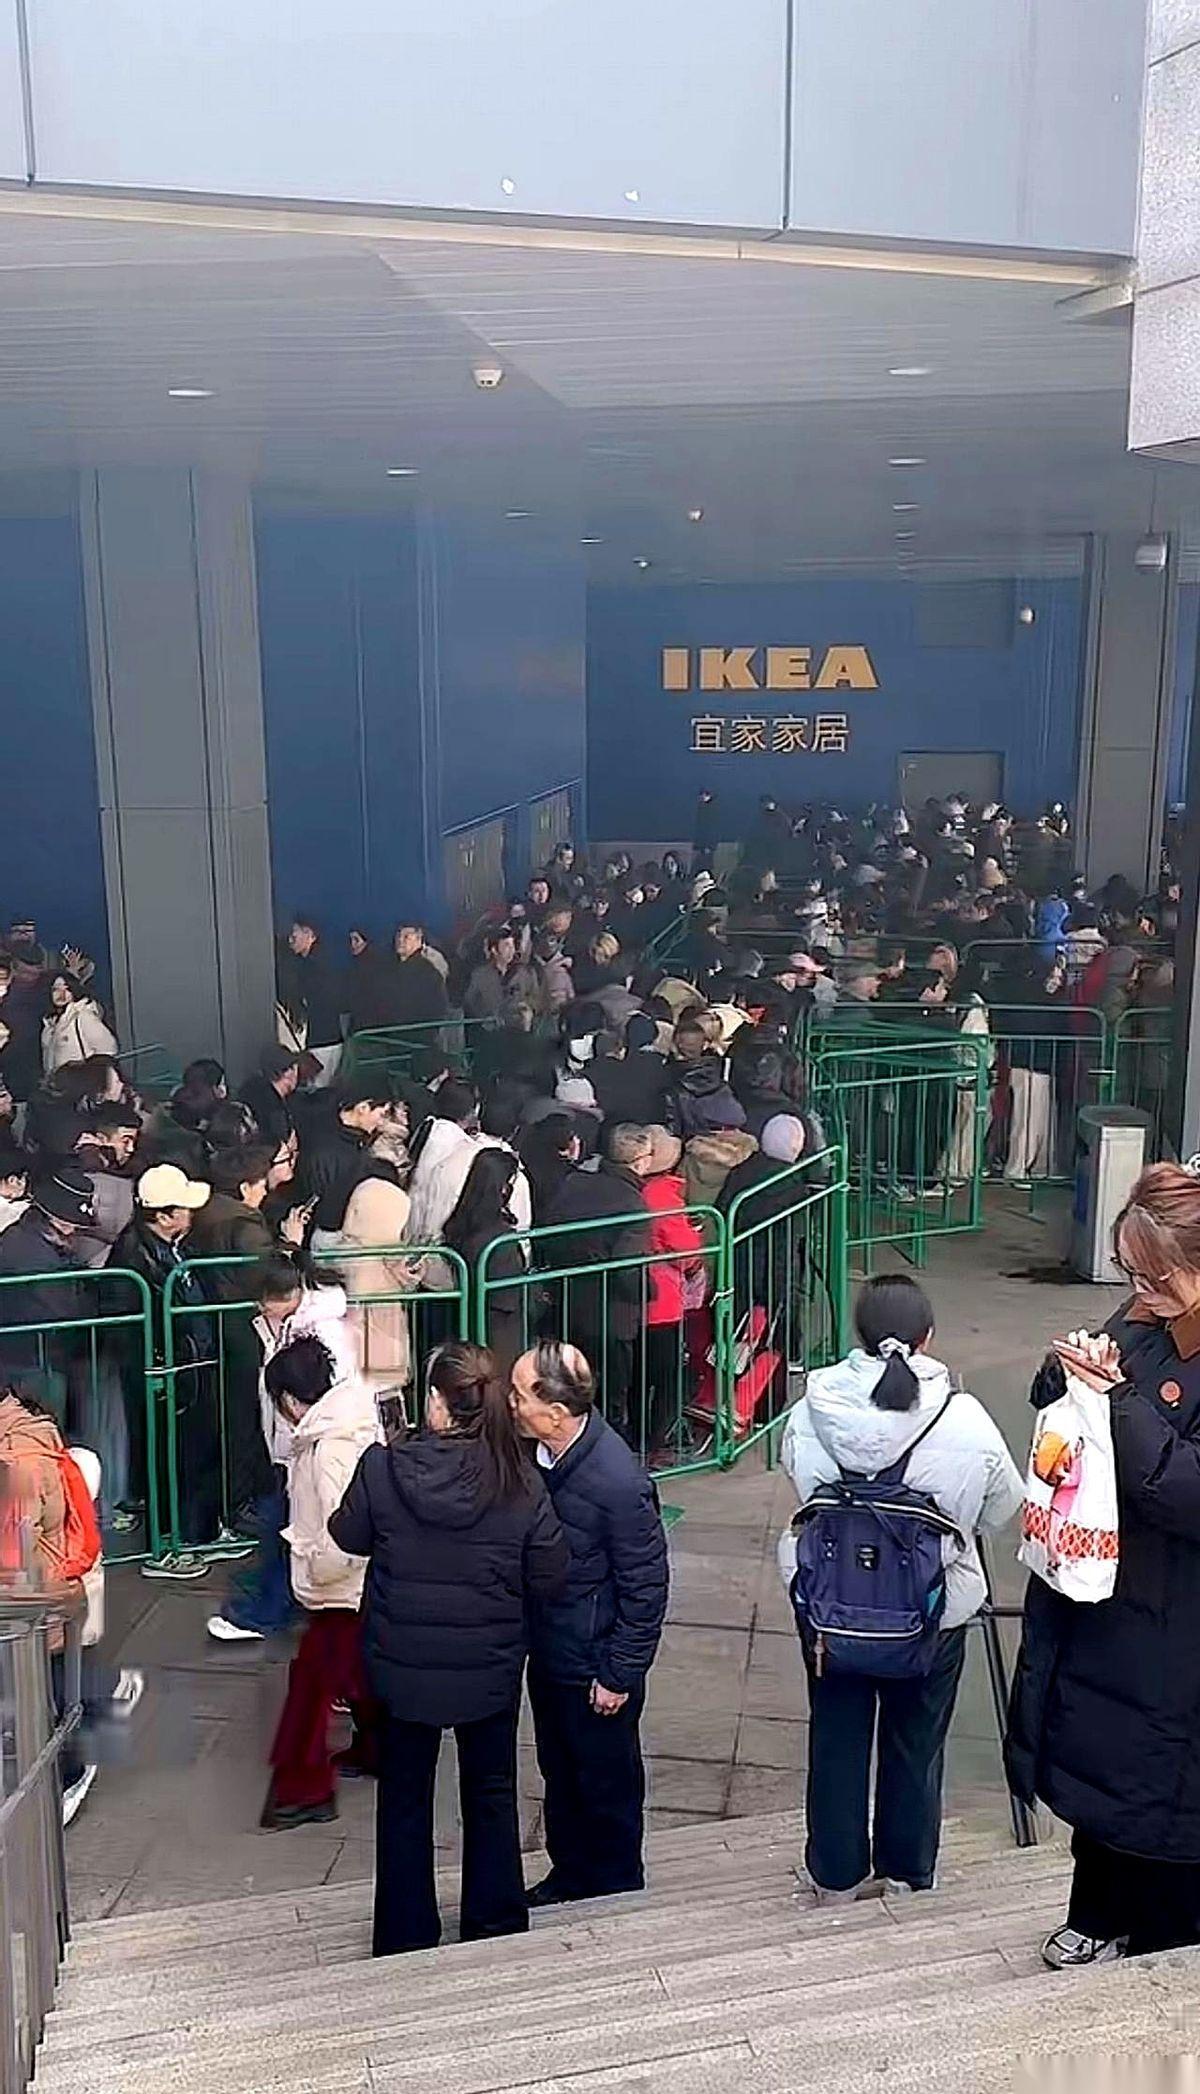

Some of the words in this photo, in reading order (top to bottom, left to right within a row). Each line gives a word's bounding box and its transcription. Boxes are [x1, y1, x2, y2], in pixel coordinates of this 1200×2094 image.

[662, 646, 879, 689] IKEA
[690, 713, 849, 752] 宜家家居
